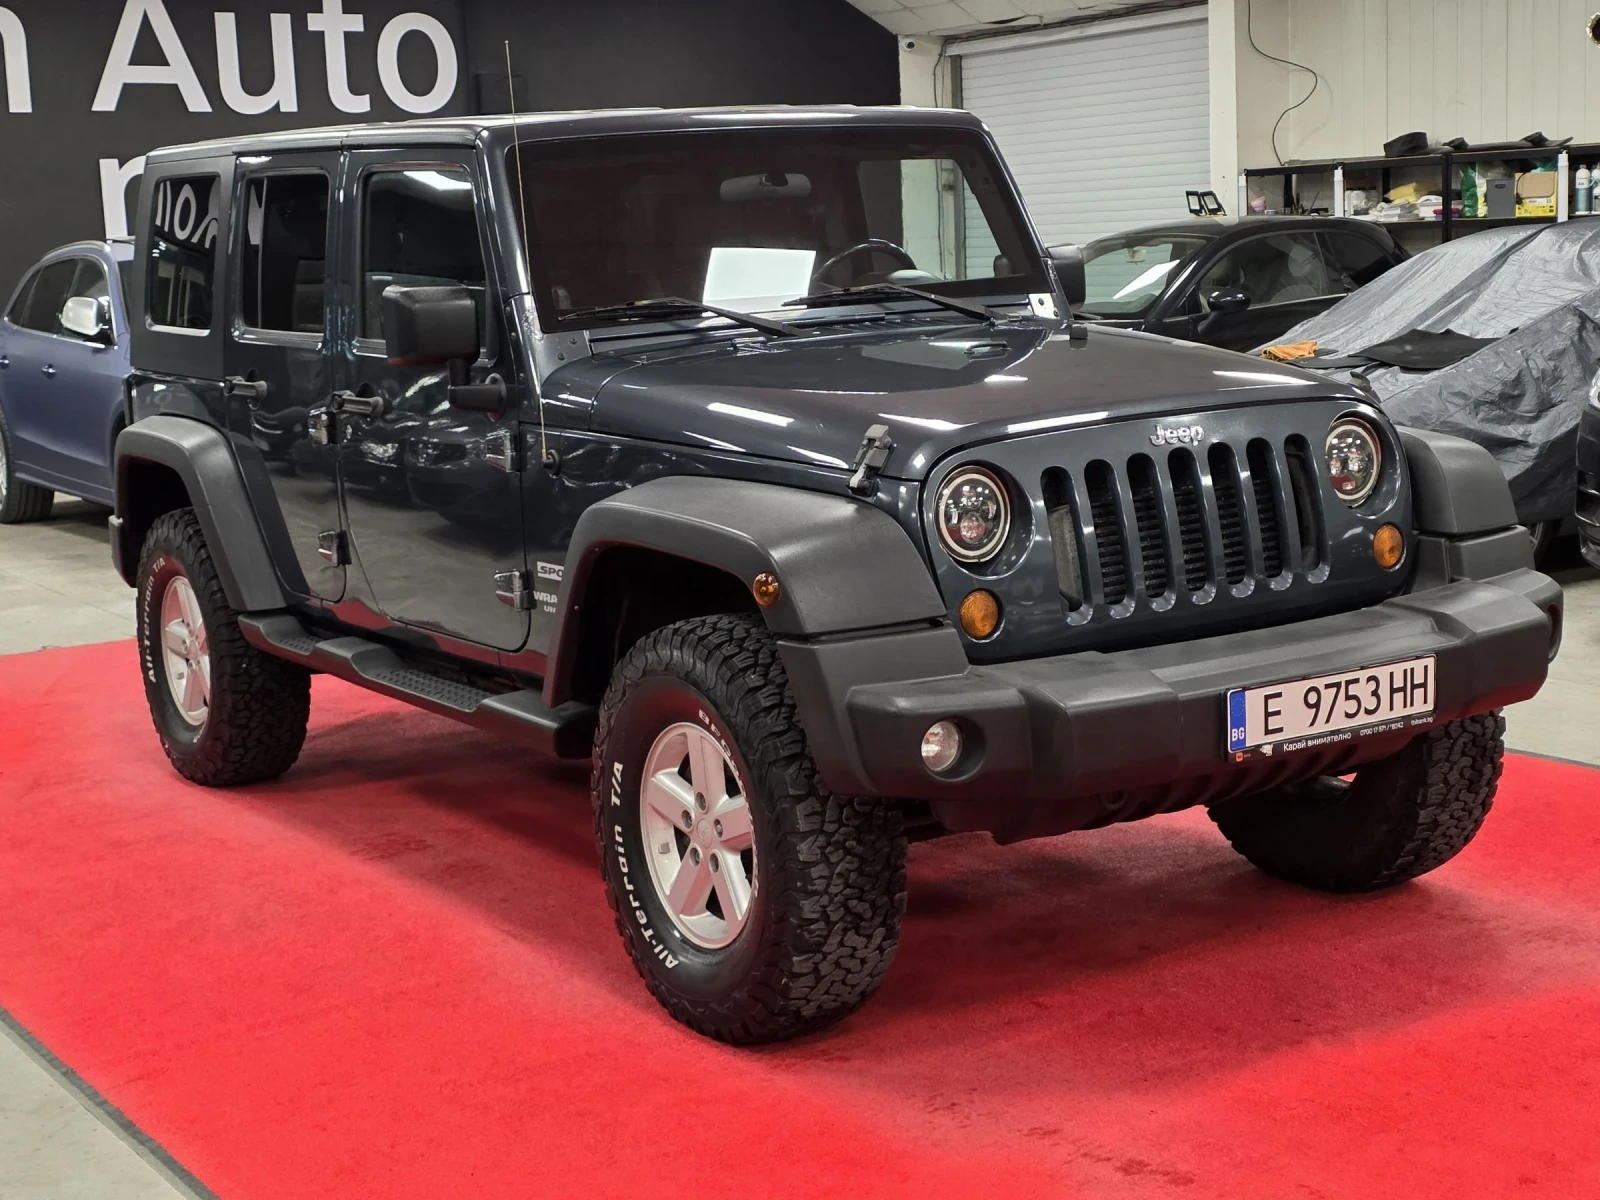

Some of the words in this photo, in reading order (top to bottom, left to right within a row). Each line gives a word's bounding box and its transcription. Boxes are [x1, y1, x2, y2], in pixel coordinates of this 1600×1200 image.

[91, 0, 458, 115] Auto
[1149, 423, 1205, 447] Jeep
[1231, 727, 1245, 742] BG
[1263, 691, 1284, 737] E
[1283, 739, 1306, 752] Карай
[1307, 732, 1352, 748] внимателно
[611, 760, 624, 806] T/A
[612, 825, 680, 970] All-Terrain
